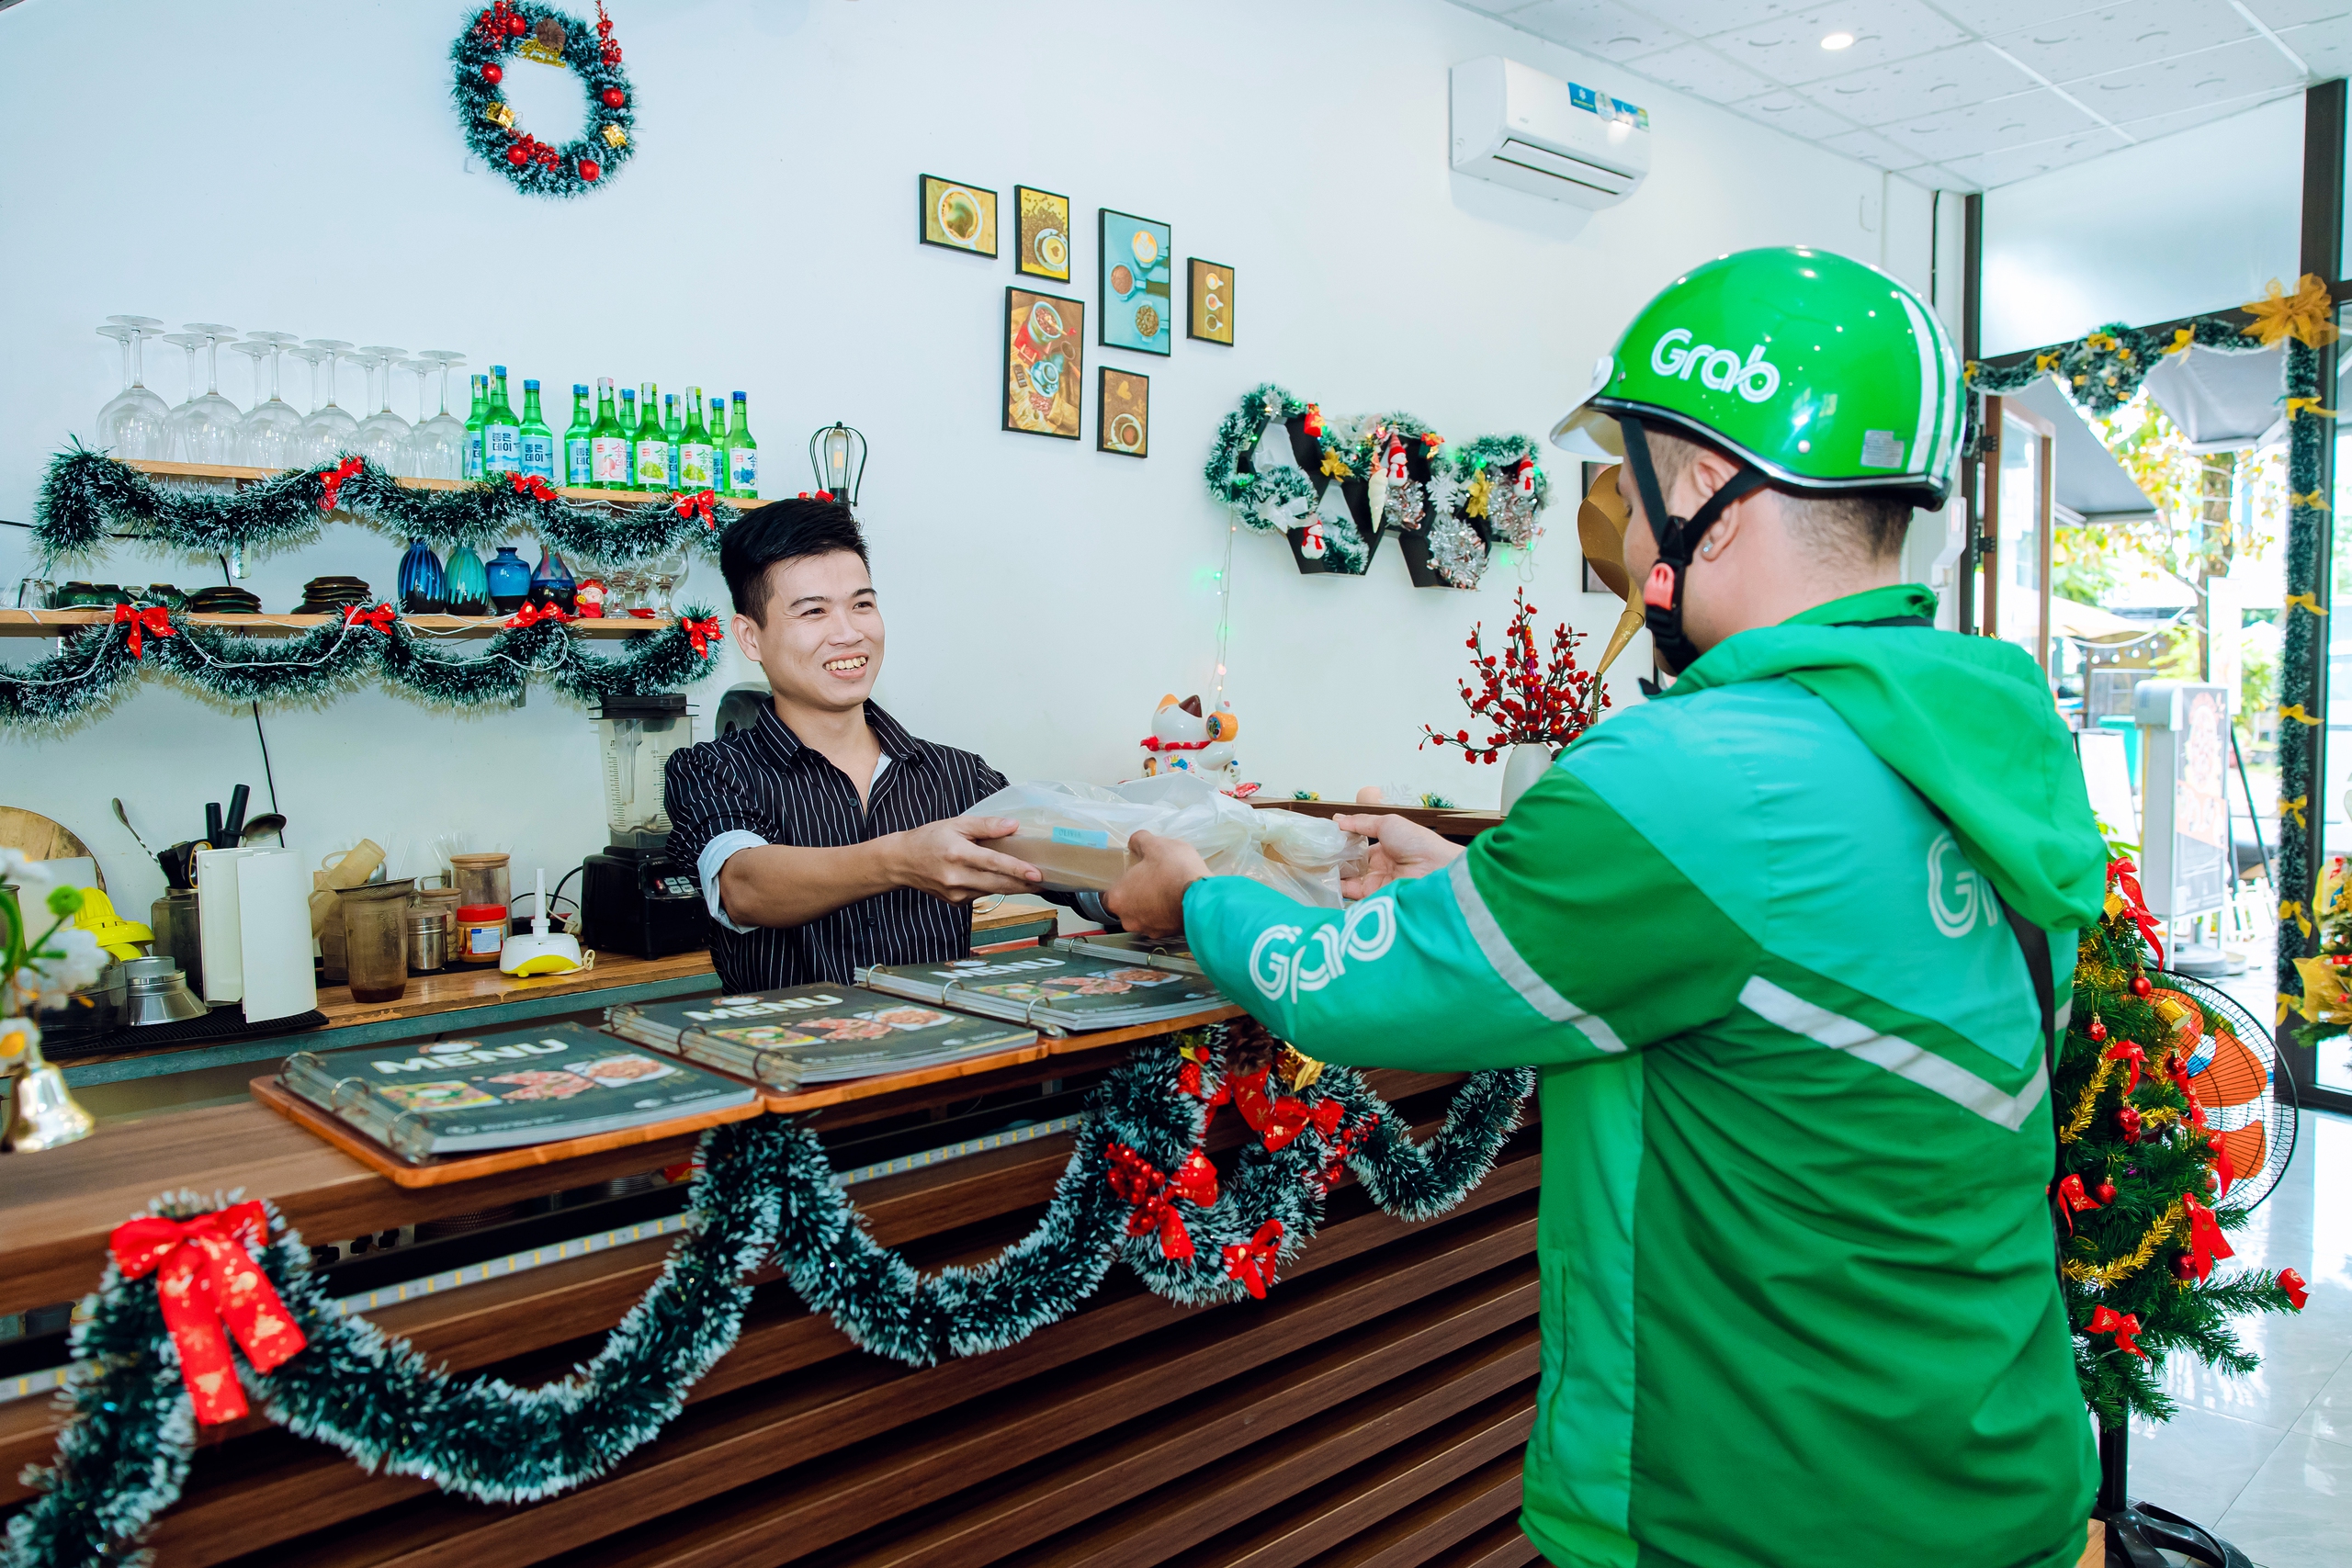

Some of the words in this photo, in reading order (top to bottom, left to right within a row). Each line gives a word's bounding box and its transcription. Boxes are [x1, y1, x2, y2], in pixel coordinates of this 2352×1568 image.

[1651, 328, 1781, 403] Grab
[492, 443, 512, 451] 데이
[525, 454, 544, 462] 데이
[1928, 830, 1998, 938] Gr
[928, 957, 1066, 978] MENU
[682, 994, 843, 1021] MENU
[370, 1038, 569, 1074] MENU
